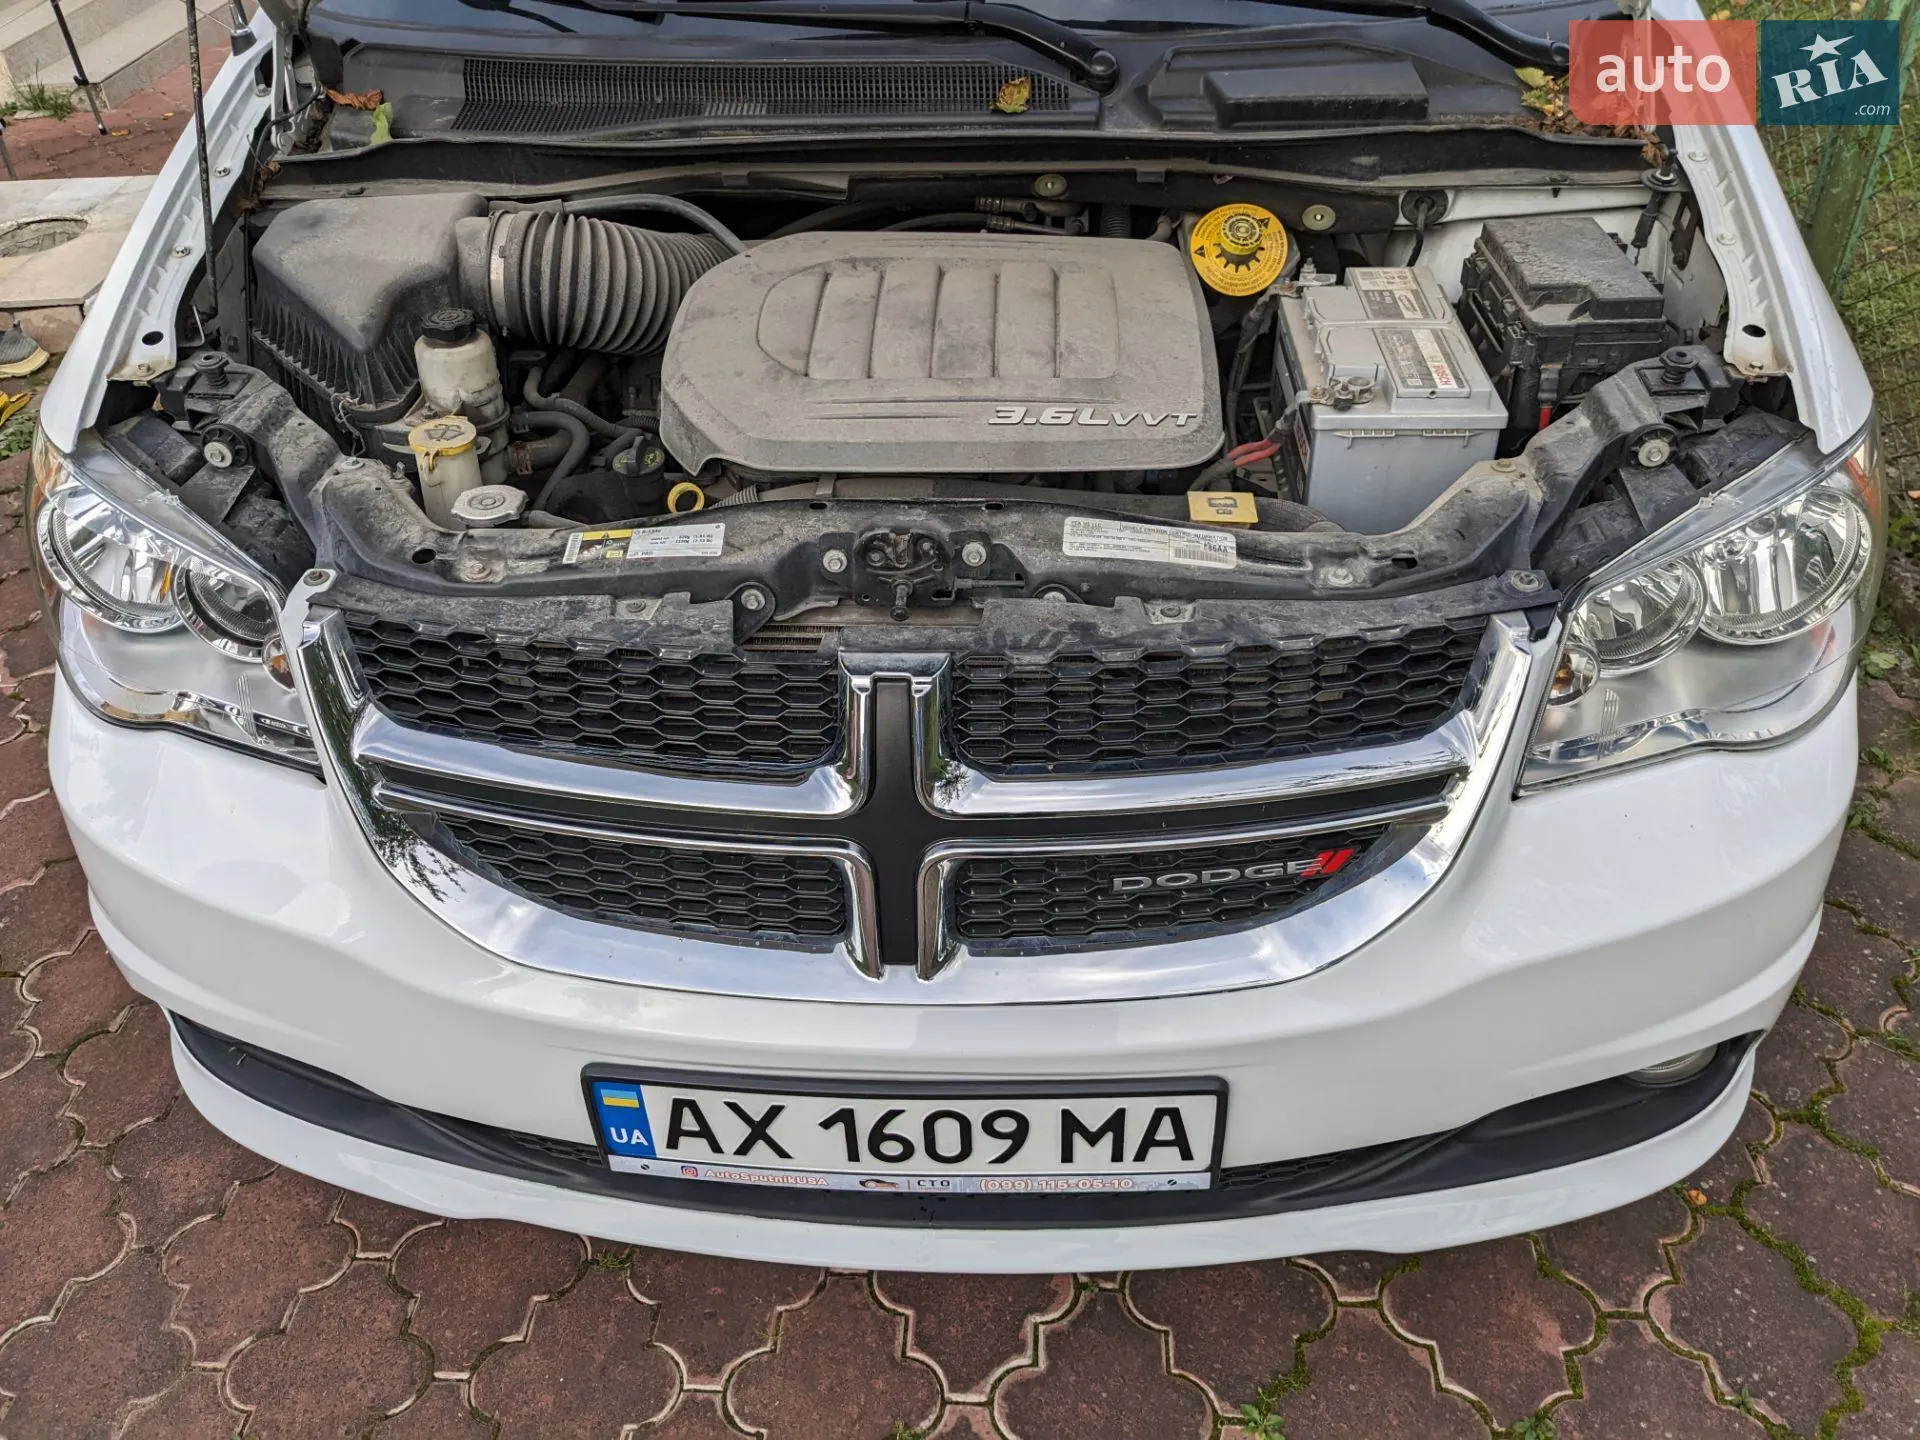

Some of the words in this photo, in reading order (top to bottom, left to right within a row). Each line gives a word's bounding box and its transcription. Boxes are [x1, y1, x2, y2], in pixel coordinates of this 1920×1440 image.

[1113, 857, 1323, 893] DODGE
[610, 1127, 648, 1146] UA
[666, 1098, 793, 1159] AX
[817, 1107, 1030, 1164] 1609
[1061, 1107, 1194, 1163] MA
[705, 1169, 828, 1186] AutoSputnikUSA
[979, 1178, 1033, 1191] (099)
[1038, 1178, 1135, 1190] 115-05-10
